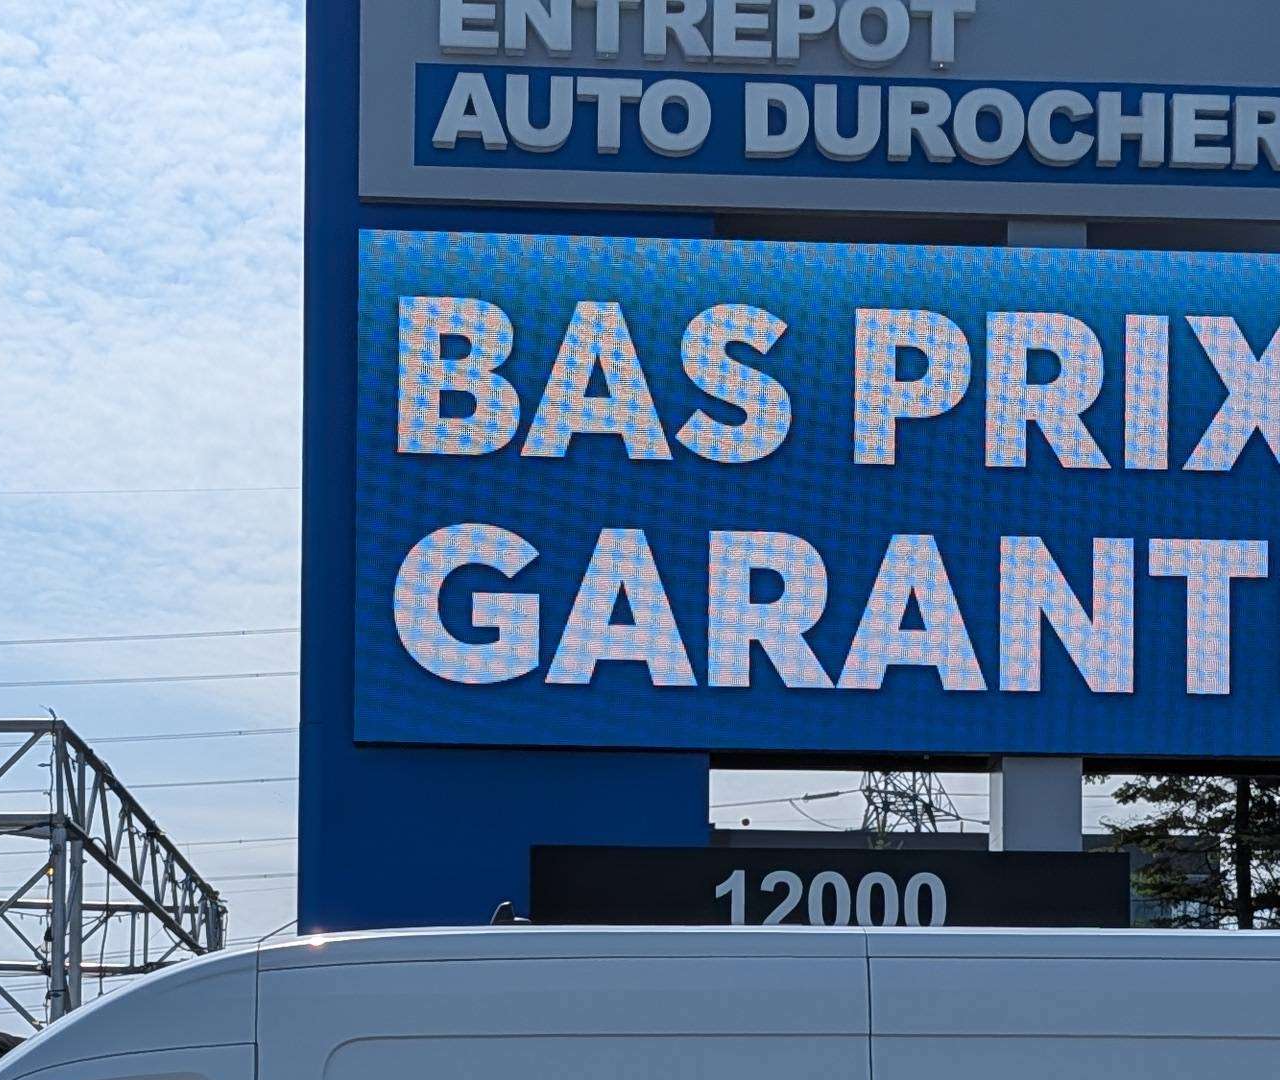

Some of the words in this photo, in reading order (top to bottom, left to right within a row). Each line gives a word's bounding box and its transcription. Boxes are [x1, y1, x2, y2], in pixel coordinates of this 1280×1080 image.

[430, 71, 713, 158] AUTO
[396, 295, 794, 465] BAS
[714, 868, 948, 928] 12000
